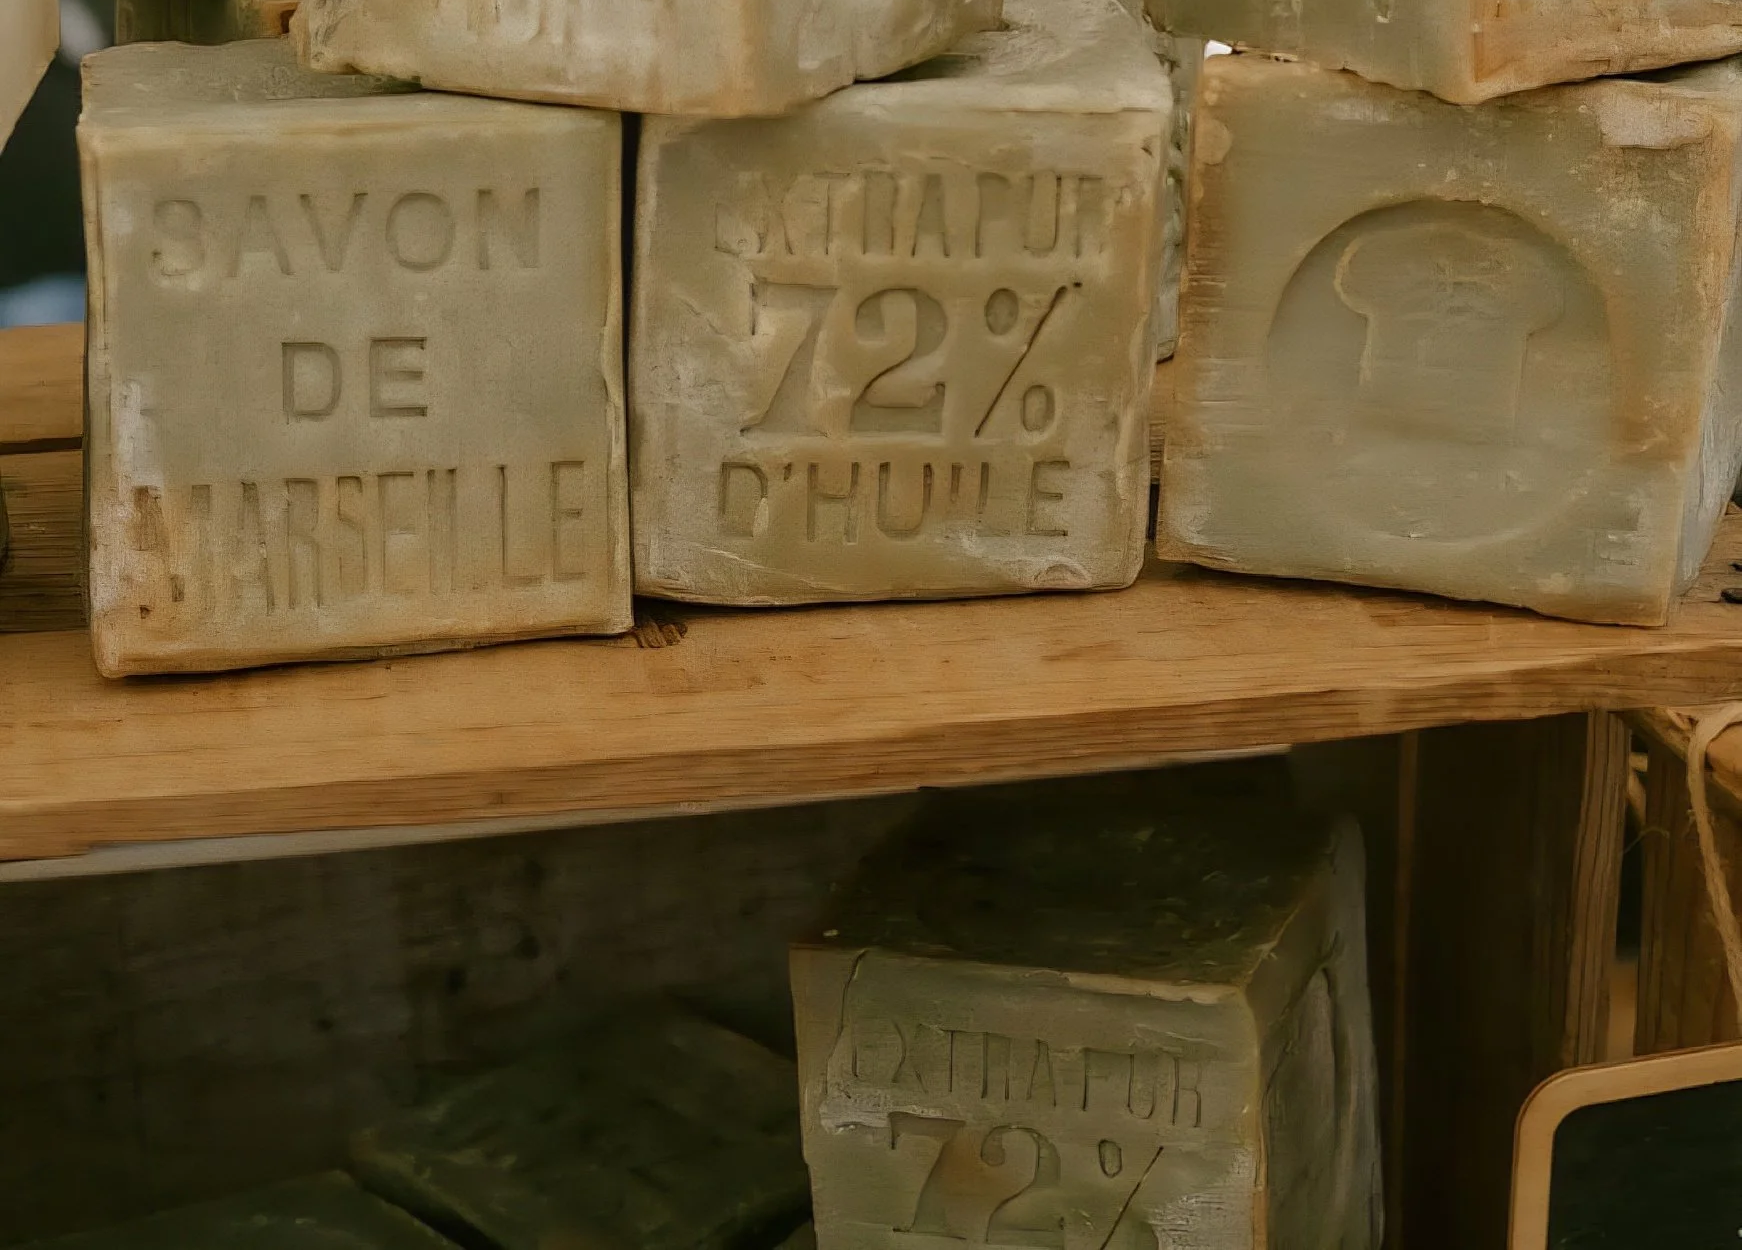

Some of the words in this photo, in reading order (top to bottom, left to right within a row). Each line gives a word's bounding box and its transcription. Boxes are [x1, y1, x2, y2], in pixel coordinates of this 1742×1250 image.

[152, 186, 541, 279] SAVON
[280, 335, 429, 421] DE
[738, 275, 1084, 440] 72%
[716, 460, 1072, 547] D'HUILE
